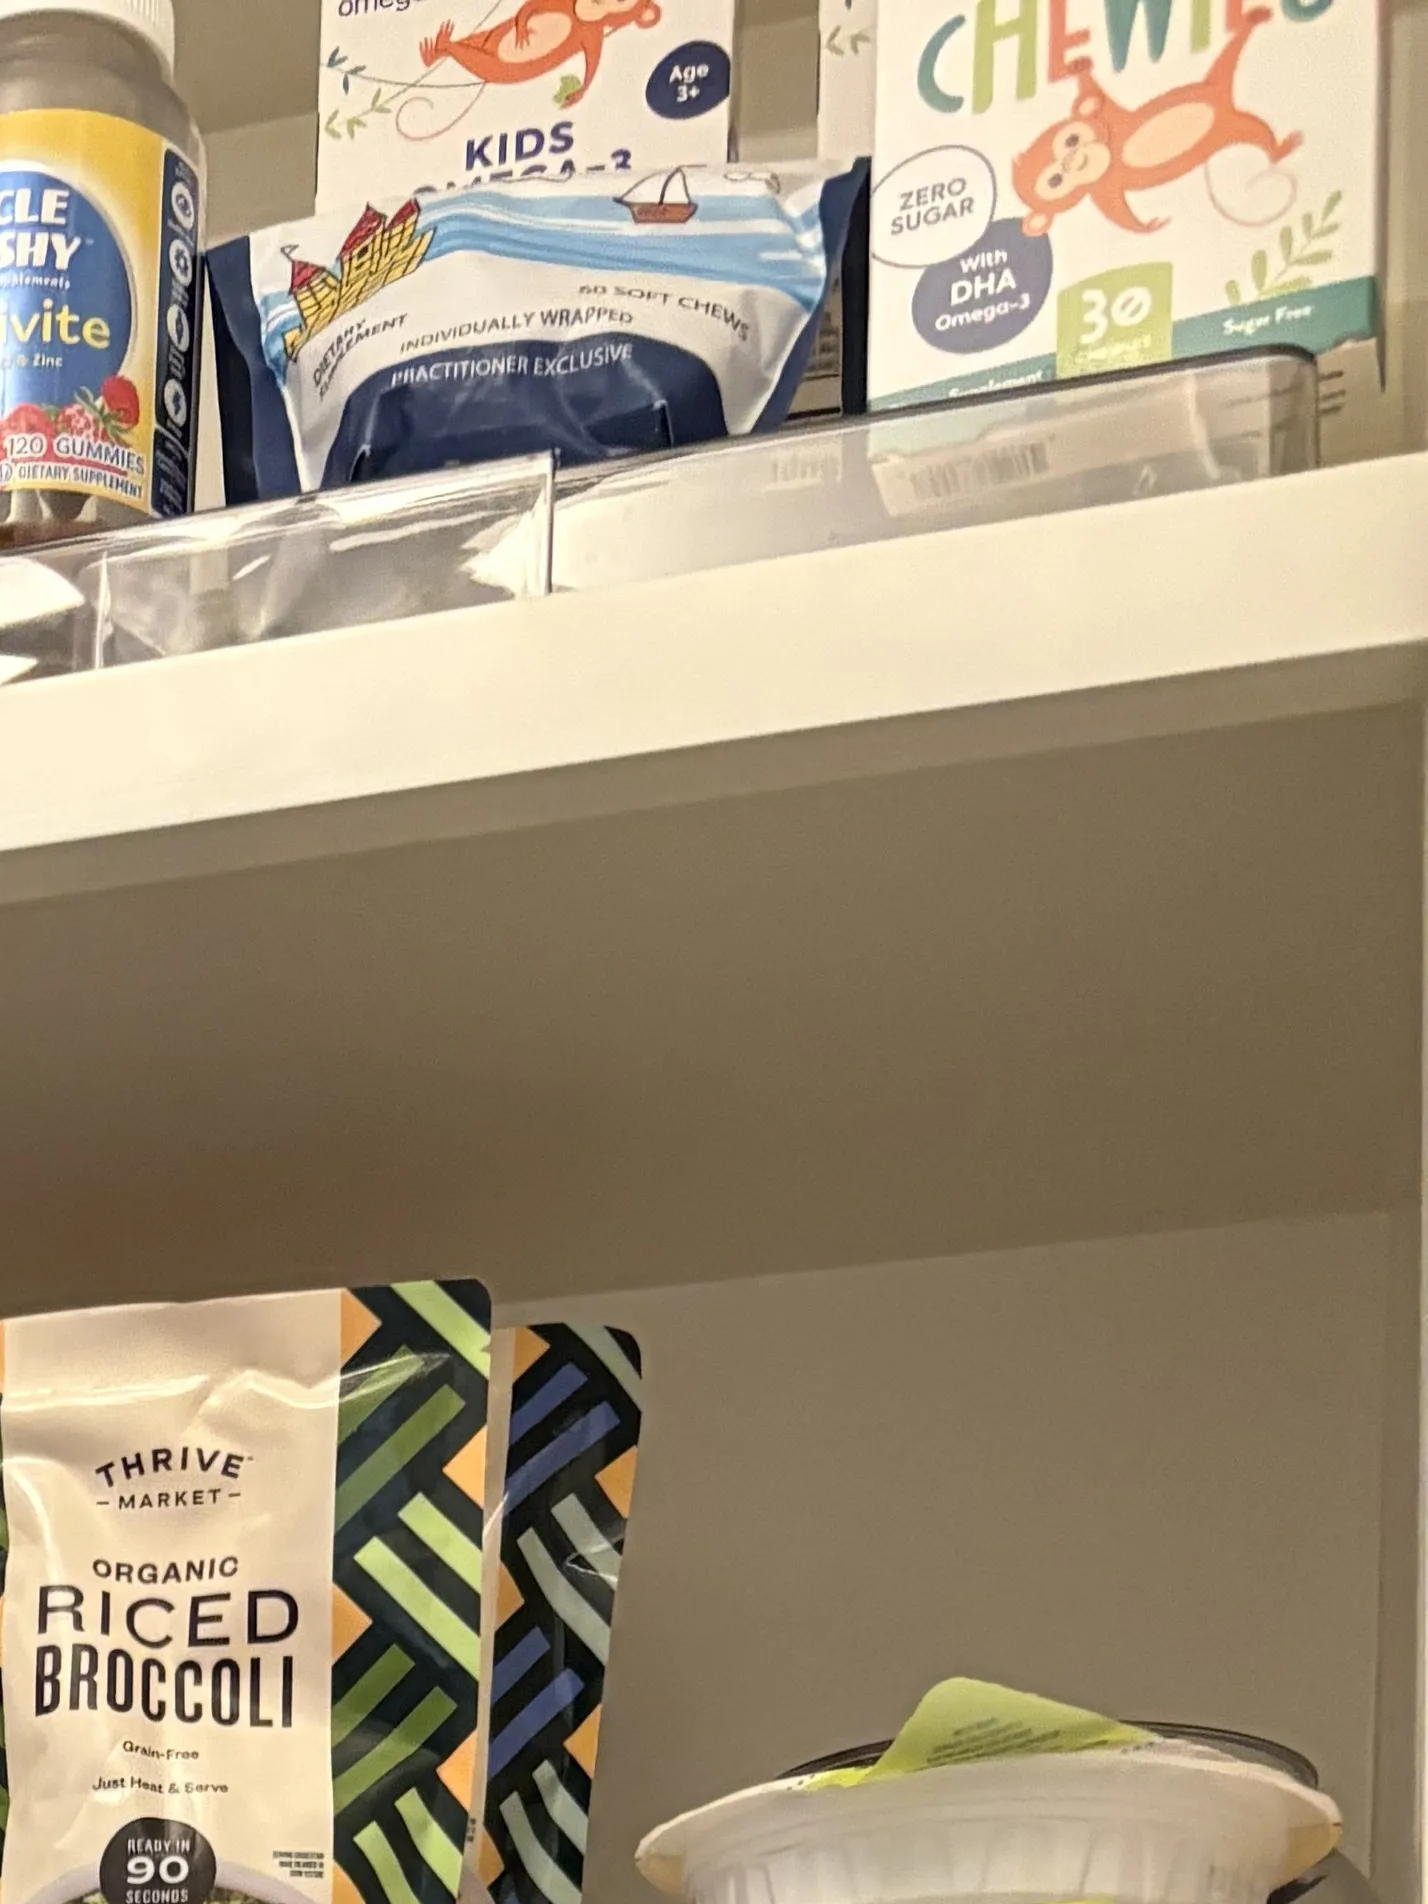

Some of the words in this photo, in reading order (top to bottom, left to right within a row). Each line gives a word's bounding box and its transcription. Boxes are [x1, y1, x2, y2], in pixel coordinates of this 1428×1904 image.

[669, 63, 709, 83] Age
[677, 85, 699, 102] 3+
[465, 120, 575, 171] KIDS
[899, 178, 967, 211] ZERO
[890, 198, 975, 236] SUGAR
[950, 275, 1017, 307] DHA
[400, 312, 534, 353] INDIVIDUALLY
[540, 307, 632, 328] WRAPPED
[614, 286, 670, 304] SOFT
[678, 297, 750, 342] CHEWS
[935, 294, 1030, 332] Omega-3
[1079, 286, 1153, 346] 30
[390, 355, 528, 387] PRACTITIONER
[533, 343, 632, 377] EXCLUSIVE
[8, 437, 44, 457] 120
[55, 436, 145, 475] GUMMIES
[95, 1445, 245, 1489] THRIVE
[117, 1488, 222, 1511] MARKET
[92, 1555, 240, 1585] ORGANIC
[36, 1583, 300, 1649] RICED
[34, 1643, 295, 1729] BROCCOLI
[122, 1740, 200, 1761] Grain-Free
[92, 1775, 127, 1793] Just
[129, 1777, 164, 1794] Heat
[184, 1782, 230, 1795] Serve
[126, 1837, 172, 1854] READY
[176, 1838, 191, 1853] IN
[125, 1855, 190, 1884] 90
